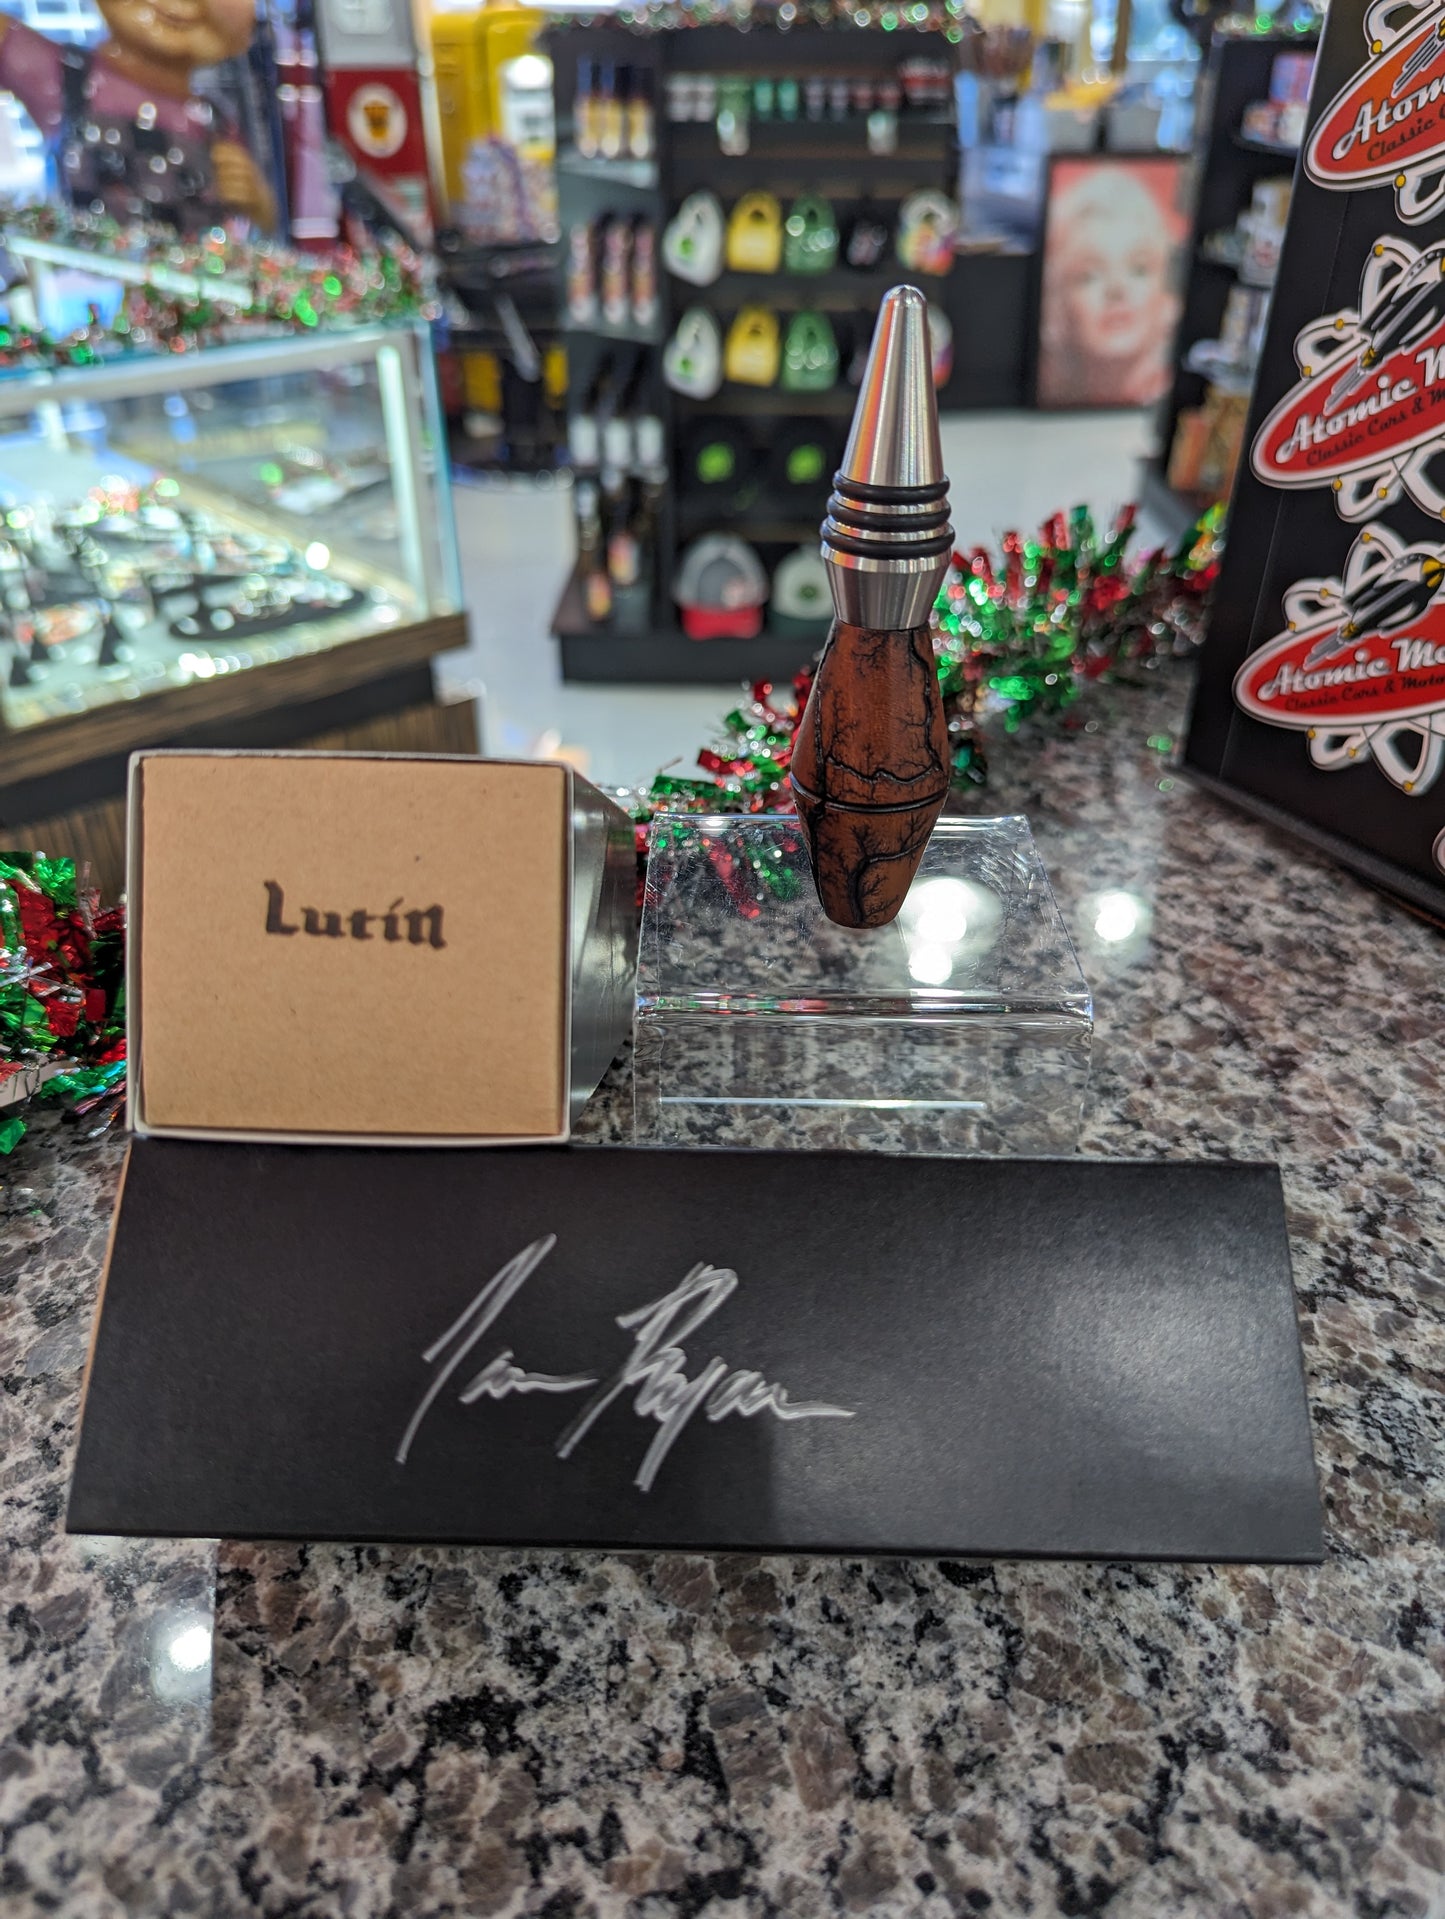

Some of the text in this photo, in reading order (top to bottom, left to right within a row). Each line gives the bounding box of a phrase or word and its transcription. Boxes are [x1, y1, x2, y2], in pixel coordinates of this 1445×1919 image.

[1367, 117, 1436, 161] Classic
[1275, 373, 1418, 464] Atomic
[1307, 431, 1364, 466] Classic
[1367, 410, 1407, 436] Cars
[1412, 396, 1424, 415] &
[1257, 647, 1391, 701] Atomic
[1285, 693, 1337, 711] Classic
[1341, 683, 1379, 700] Cars
[1384, 678, 1396, 694] &
